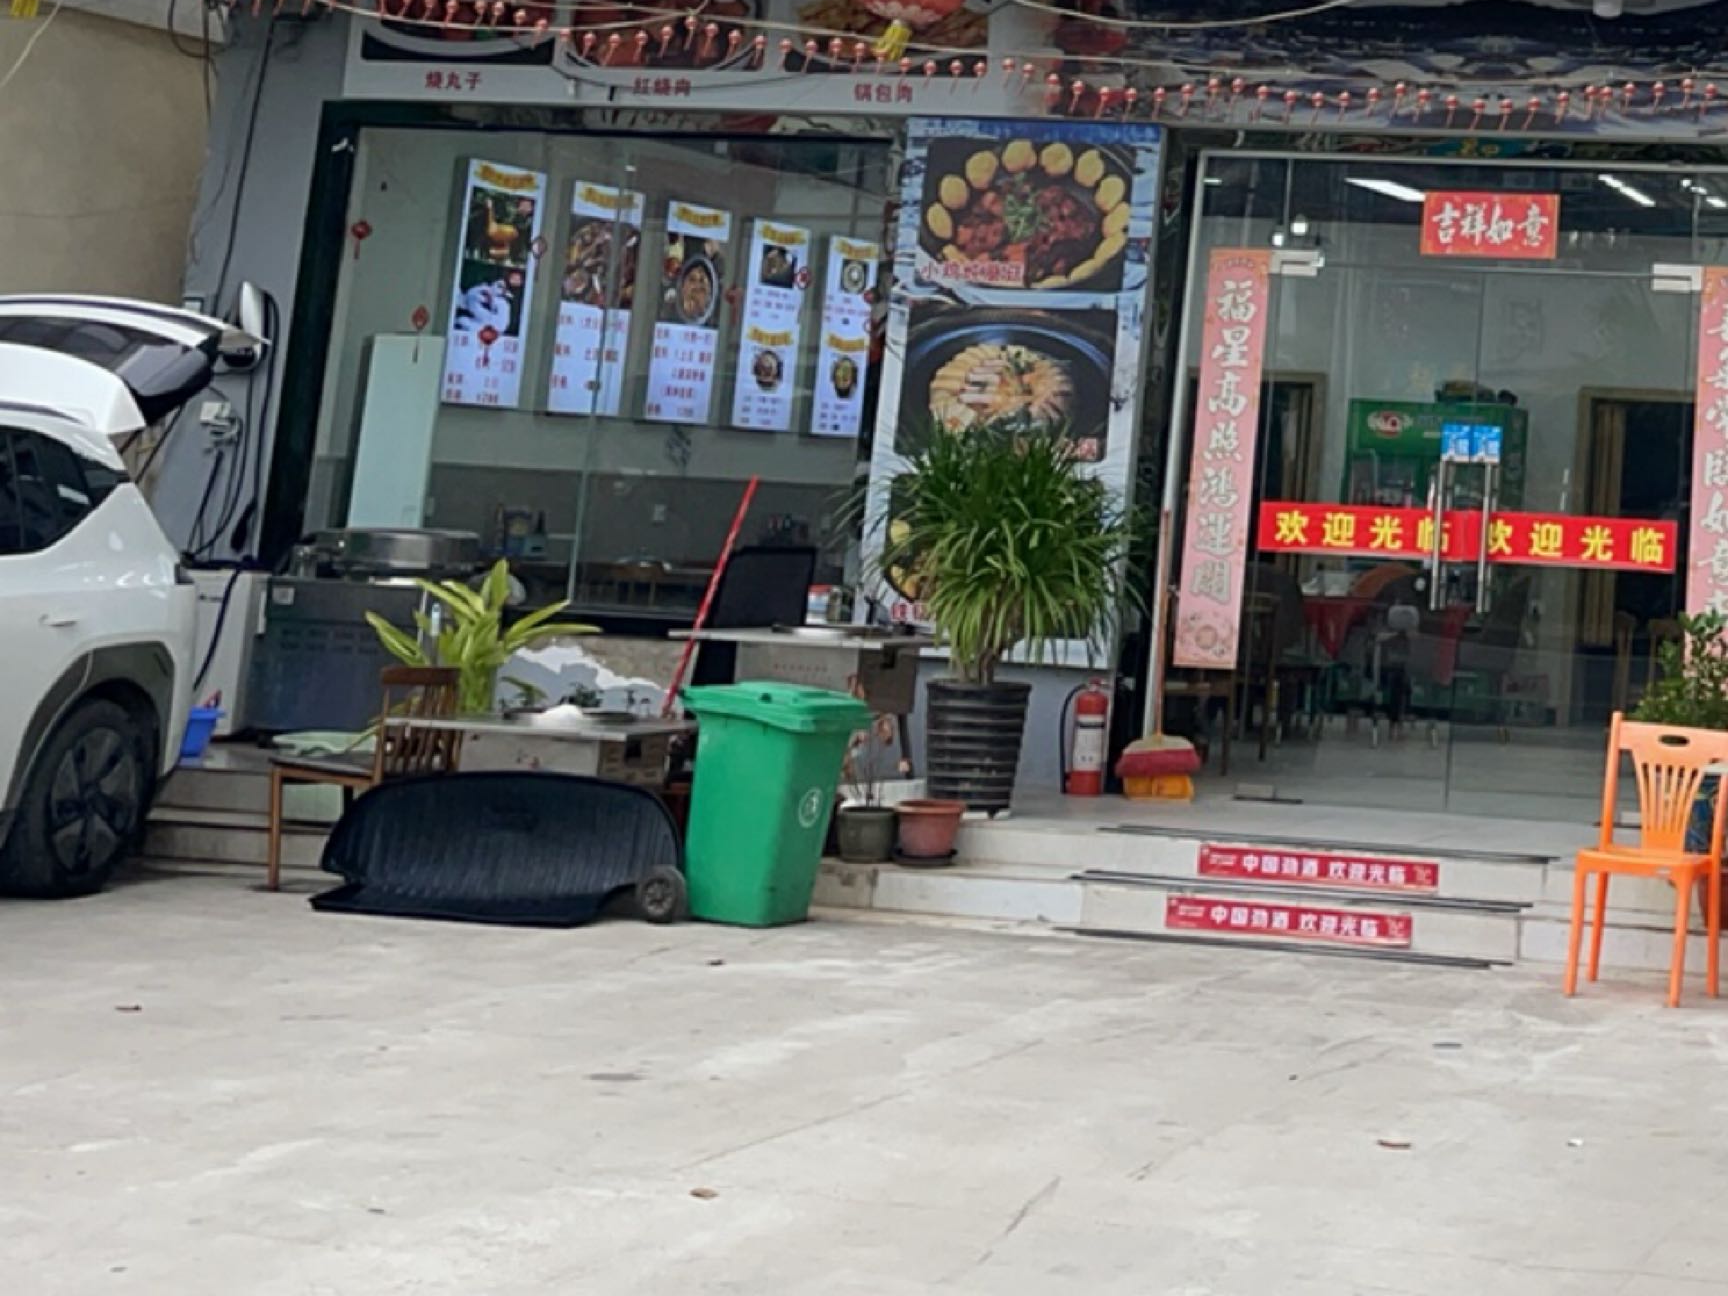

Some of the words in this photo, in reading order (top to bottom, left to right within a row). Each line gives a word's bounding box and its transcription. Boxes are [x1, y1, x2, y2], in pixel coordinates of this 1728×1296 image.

[1432, 201, 1550, 247] 吉祥如意
[1274, 511, 1451, 554] 欢迎光临
